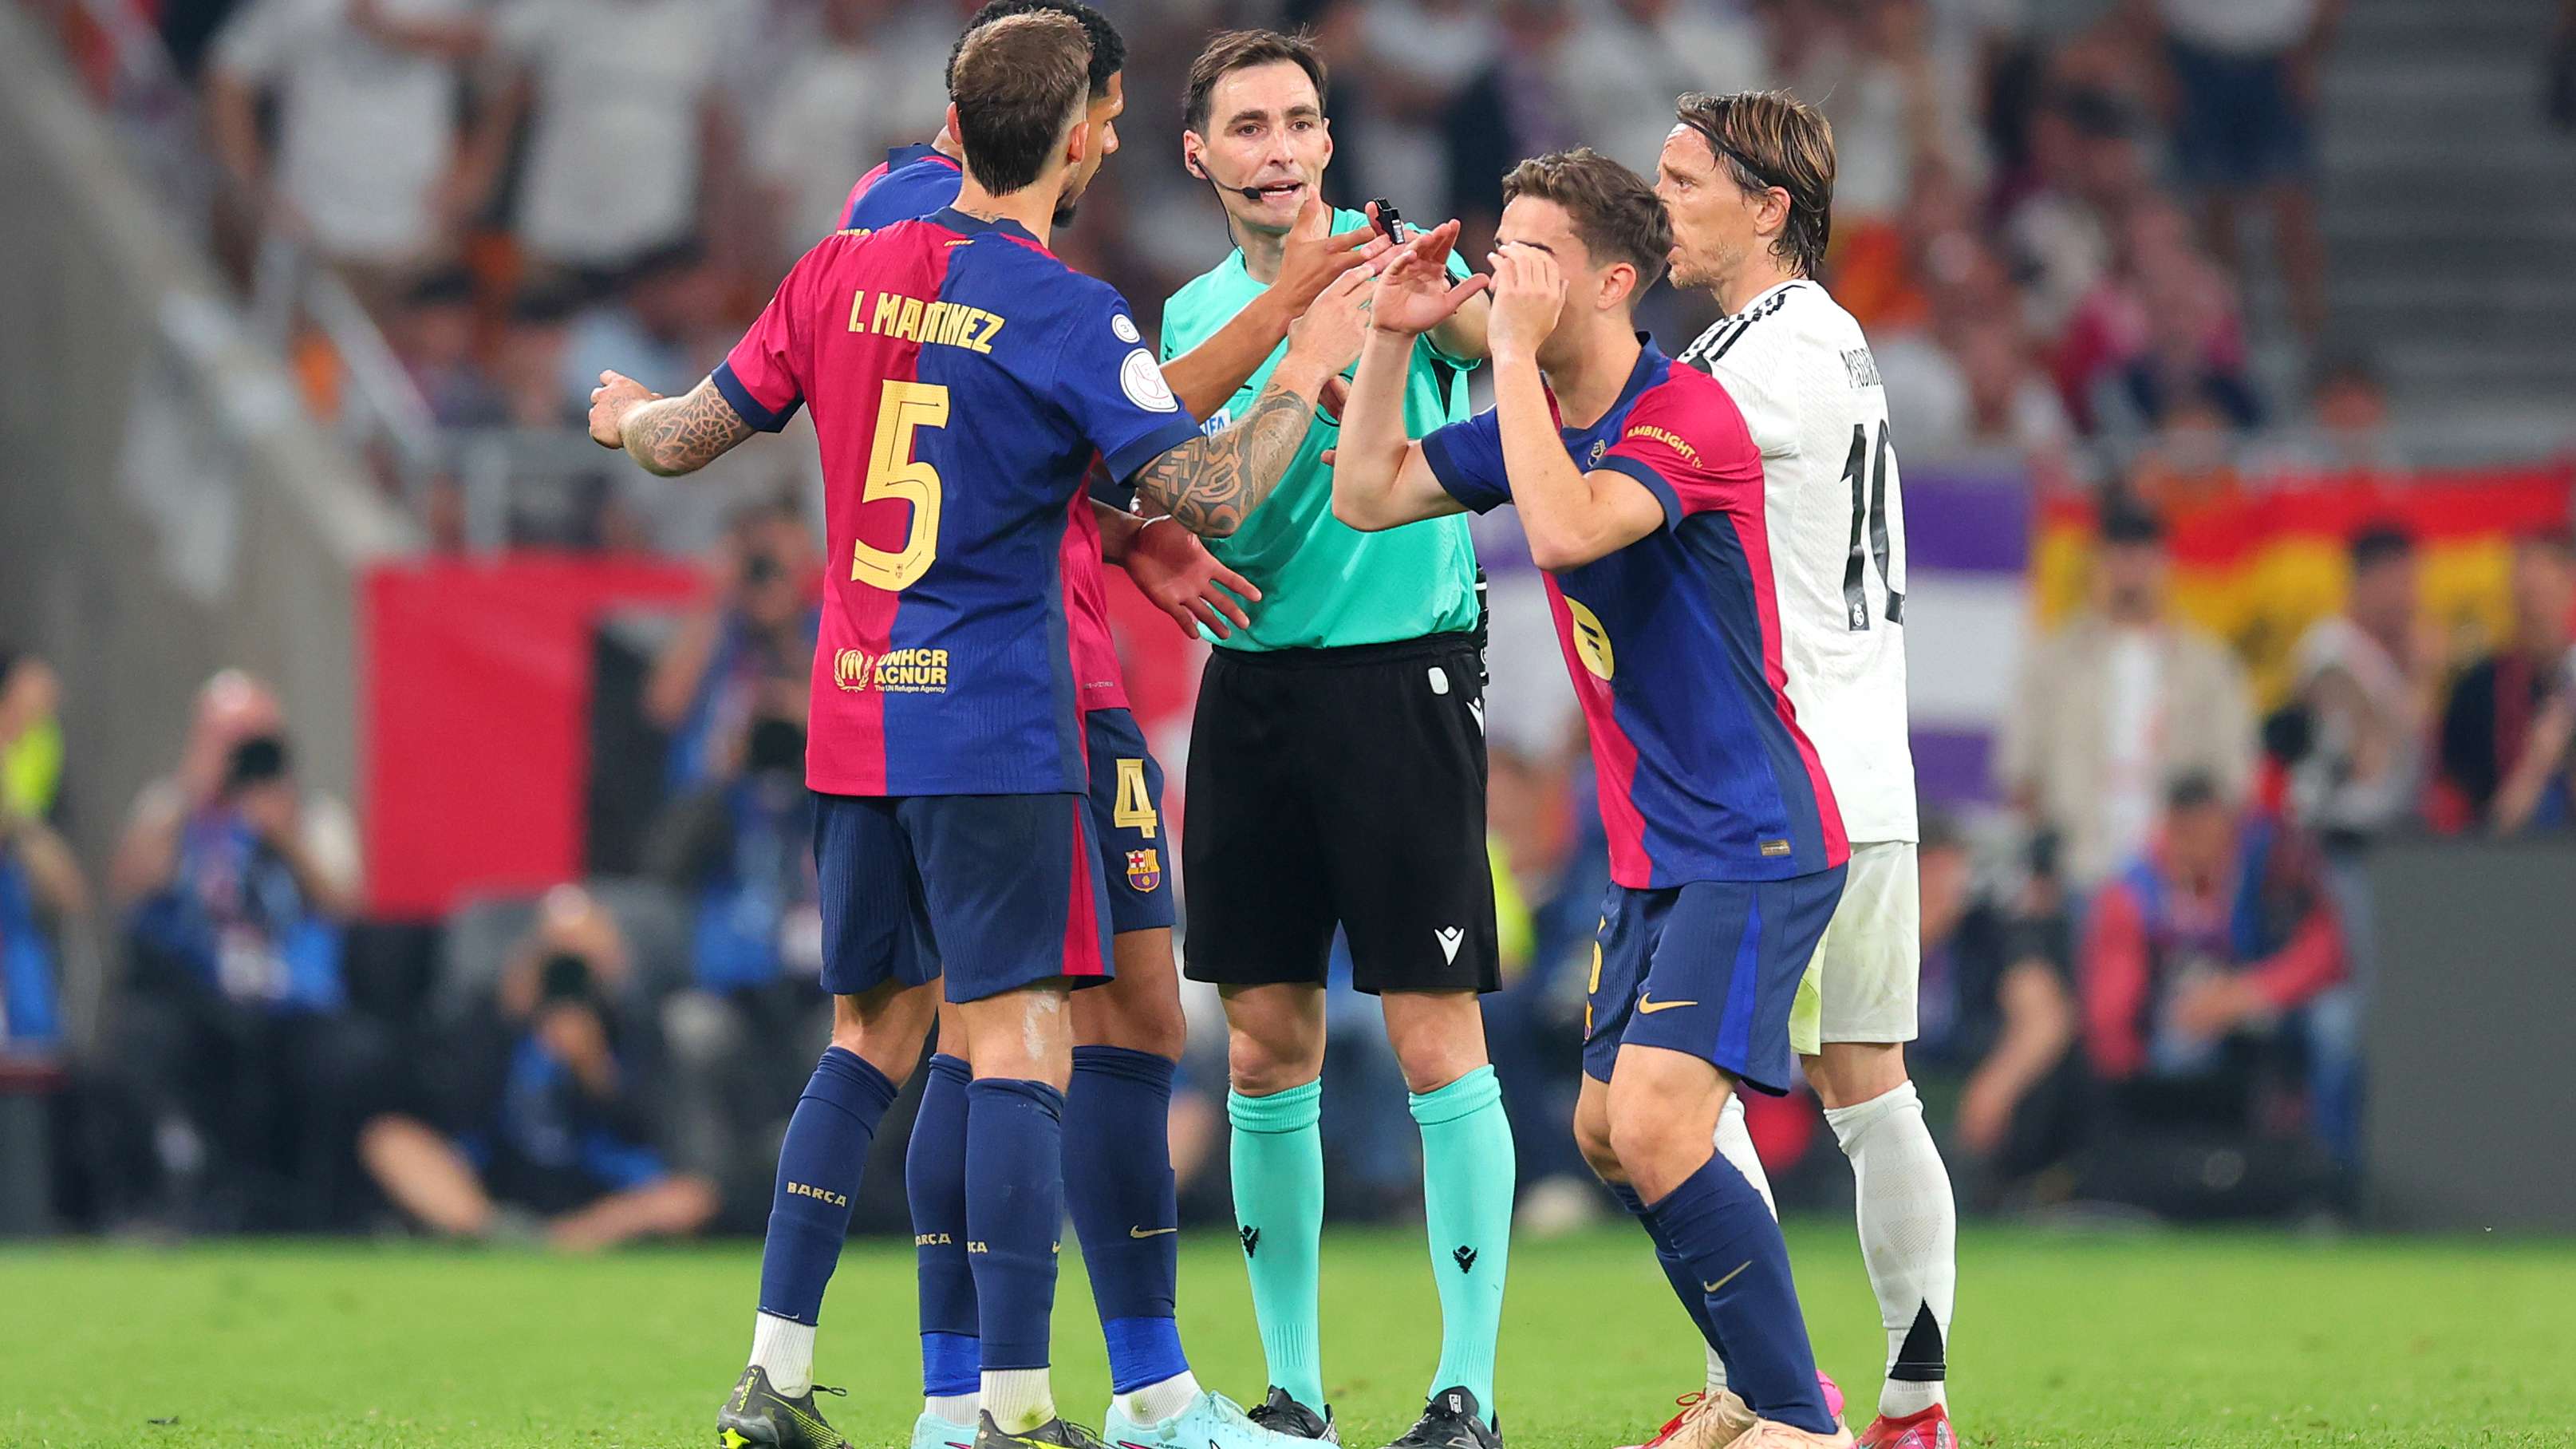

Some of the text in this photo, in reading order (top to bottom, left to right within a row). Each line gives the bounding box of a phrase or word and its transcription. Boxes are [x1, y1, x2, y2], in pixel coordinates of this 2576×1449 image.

[848, 290, 865, 332] I.
[1627, 425, 1695, 459] AMBILIGHT
[850, 379, 951, 592] 5
[876, 649, 948, 667] UNHCR
[874, 667, 947, 685] ACNUR
[1114, 759, 1158, 838] 4
[787, 1182, 846, 1207] BARÇA
[915, 1234, 951, 1247] ARÇA
